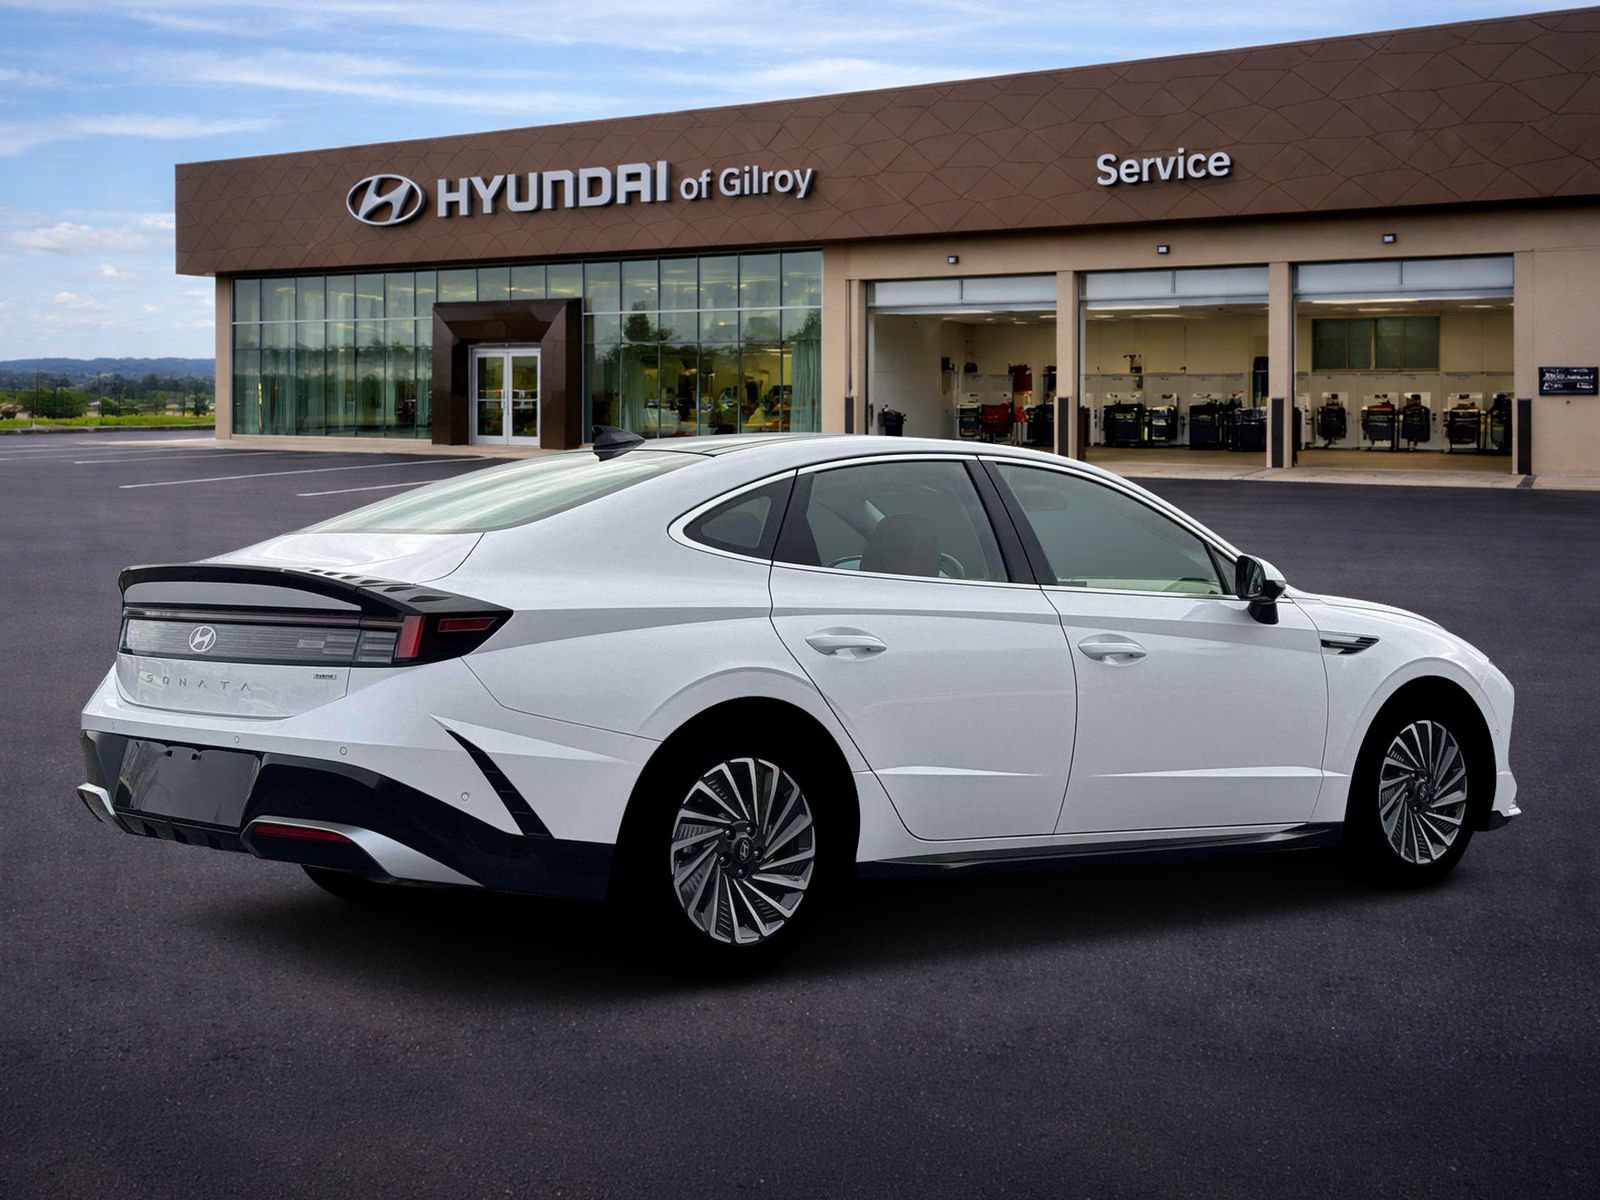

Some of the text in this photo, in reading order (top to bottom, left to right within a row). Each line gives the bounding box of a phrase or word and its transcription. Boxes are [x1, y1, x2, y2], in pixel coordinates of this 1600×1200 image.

[1096, 147, 1231, 186] Service
[436, 160, 813, 217] HYUNDAI of Gilroy
[146, 673, 252, 692] SONATA
